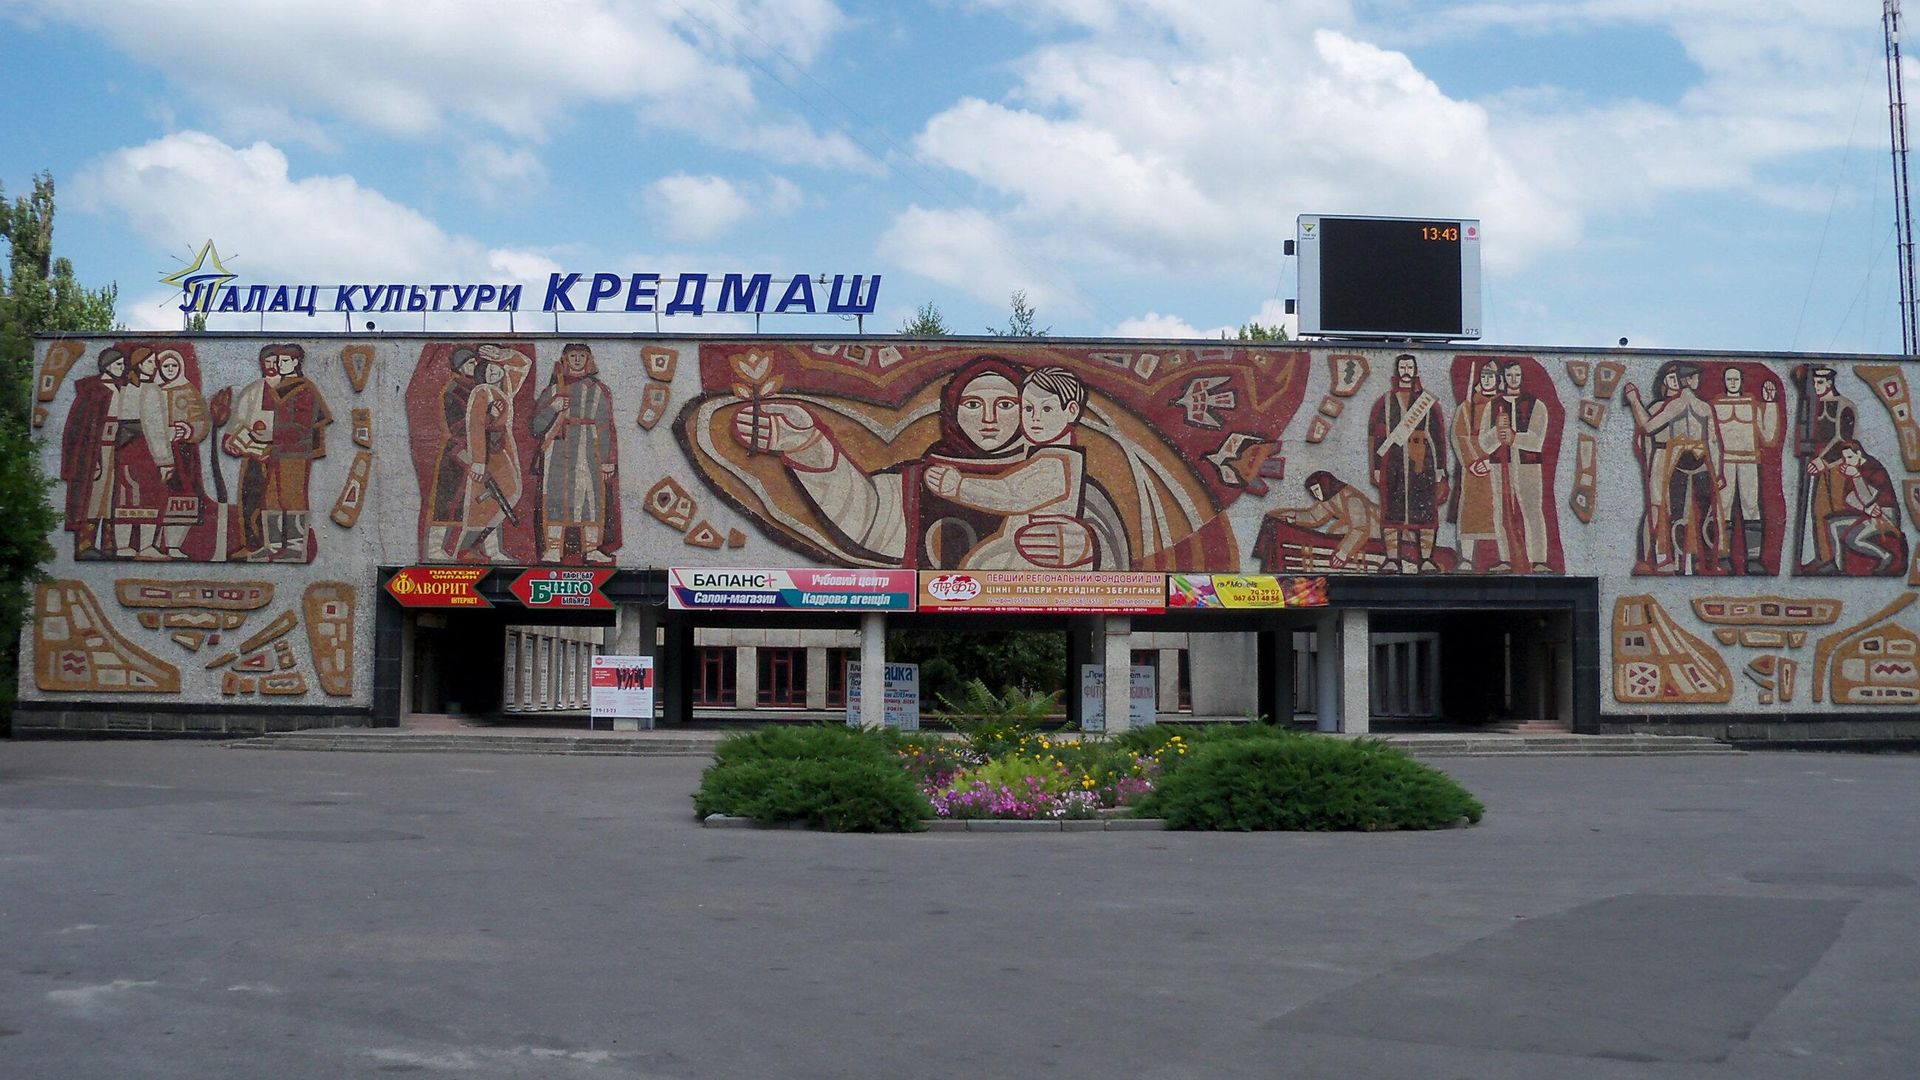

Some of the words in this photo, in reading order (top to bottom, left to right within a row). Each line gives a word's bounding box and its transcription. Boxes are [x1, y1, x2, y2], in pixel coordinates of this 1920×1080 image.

[1422, 227, 1458, 241] 13:43
[179, 274, 319, 317] ПАЛАЦ
[334, 284, 523, 313] КУЛЬТУРИ
[543, 272, 882, 317] КРЕДМАШ
[394, 577, 469, 595] ФАВОРИТ
[812, 573, 856, 586] Учбовий
[858, 575, 890, 588] центр
[1146, 574, 1161, 584] ДІМ
[530, 573, 593, 603] БІНГО
[986, 586, 1011, 594] ЦІННІ
[1016, 586, 1052, 594] ПАПЕРИ
[1106, 586, 1161, 595] ЗБЕРІГАННЯ
[694, 591, 777, 604] Салон-магазин
[802, 592, 847, 606] Кадрова
[850, 593, 891, 606] агенція
